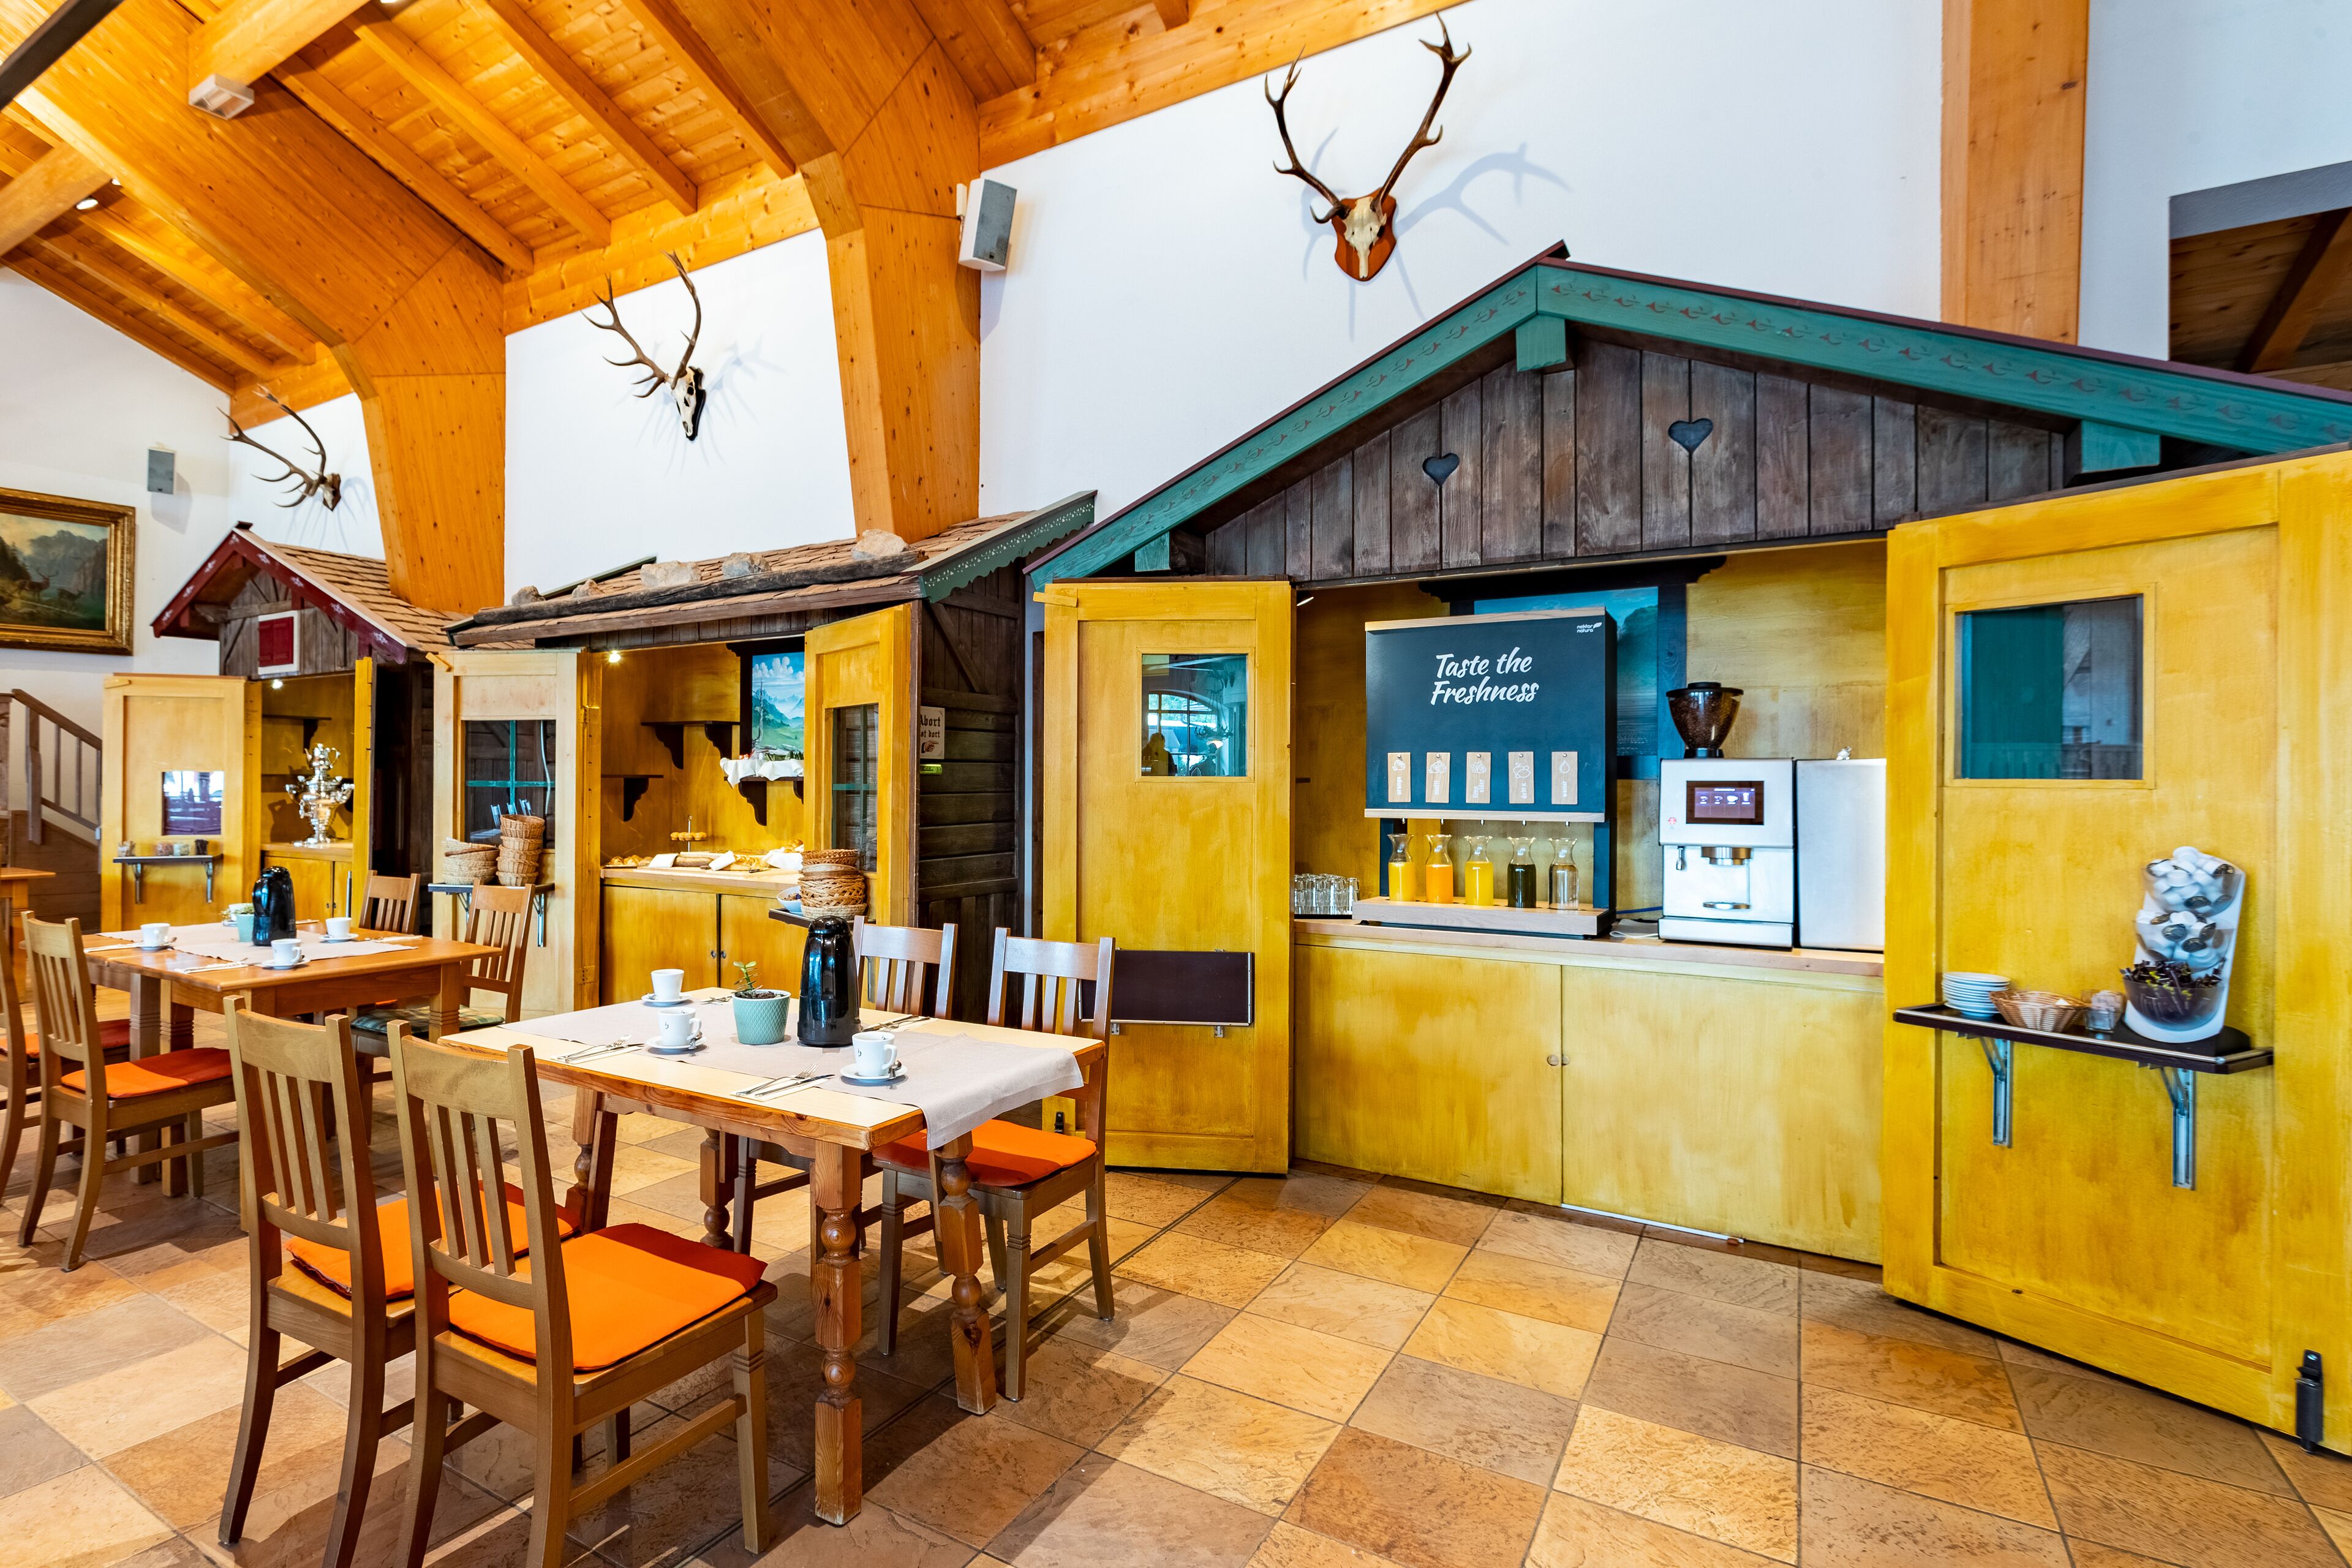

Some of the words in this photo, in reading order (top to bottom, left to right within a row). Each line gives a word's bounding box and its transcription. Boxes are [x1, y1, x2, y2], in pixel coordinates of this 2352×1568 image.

[1436, 654, 1490, 678] Taste
[1496, 647, 1532, 674] the
[1430, 676, 1539, 705] Freshness
